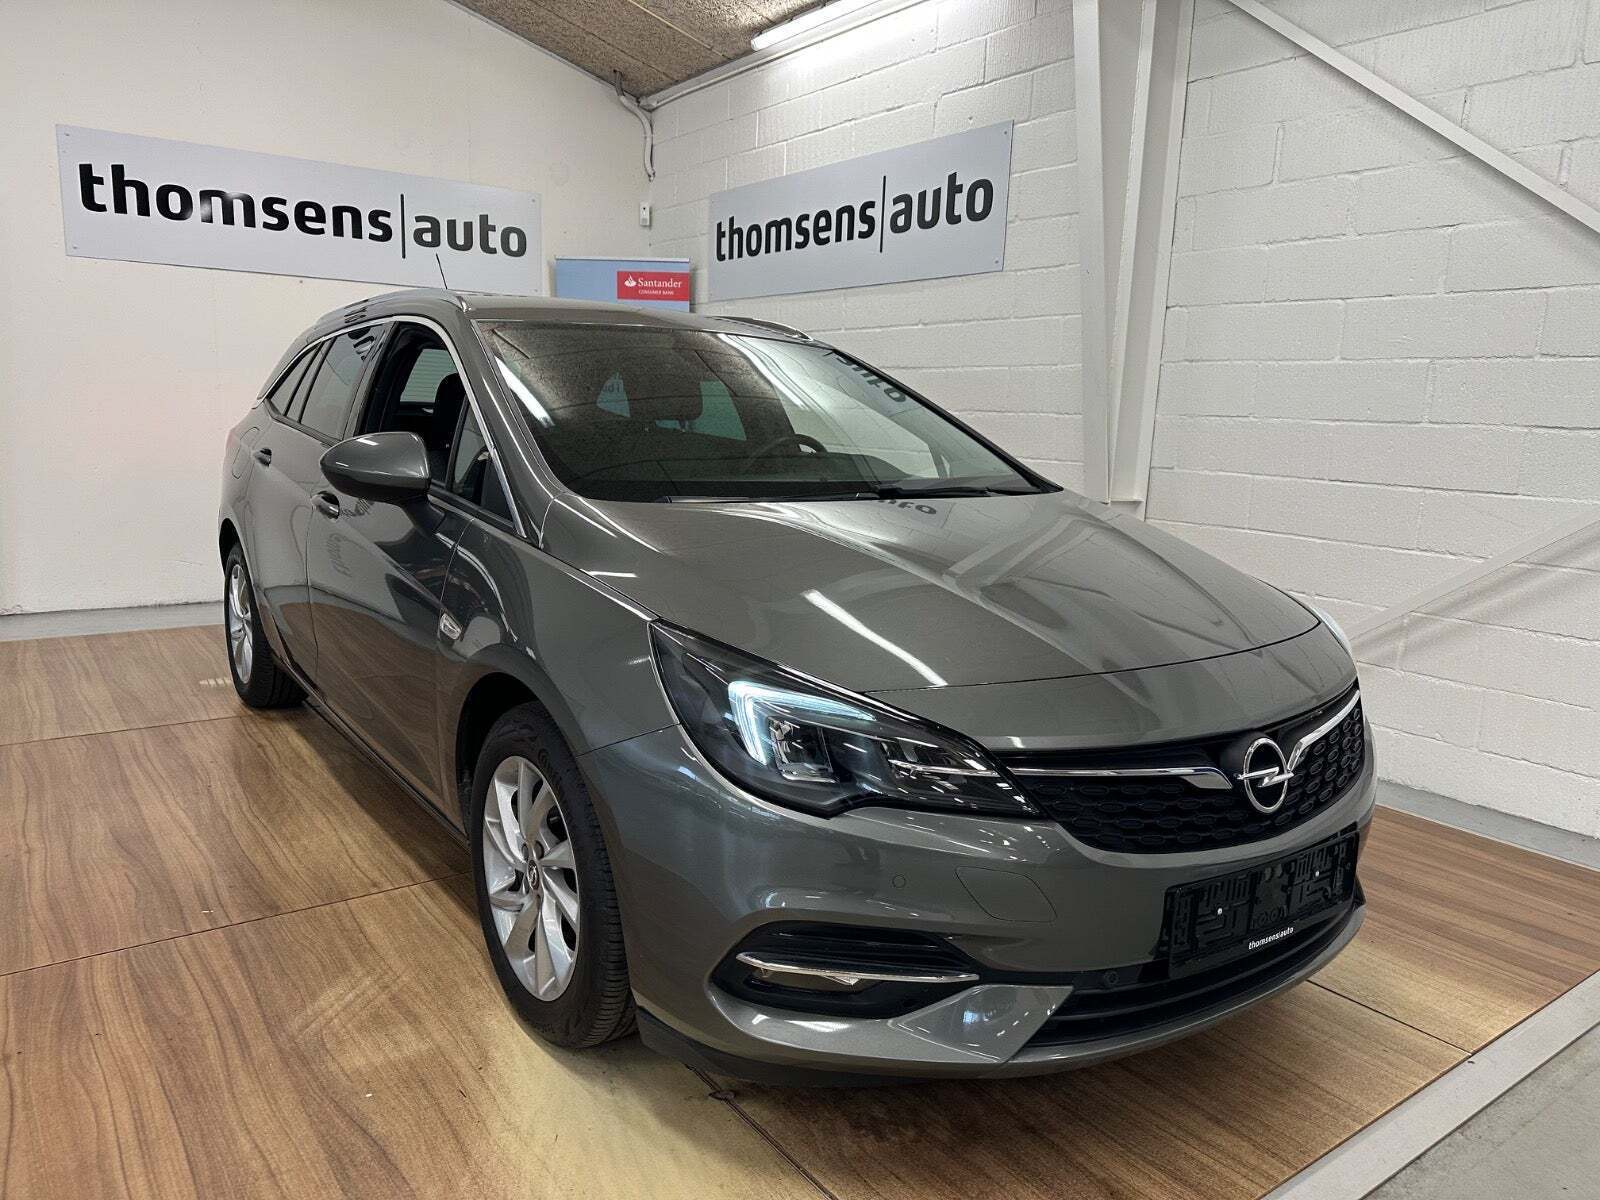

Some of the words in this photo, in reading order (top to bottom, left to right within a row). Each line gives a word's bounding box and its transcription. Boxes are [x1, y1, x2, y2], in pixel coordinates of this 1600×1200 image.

[78, 163, 393, 243] thomsens
[413, 213, 527, 258] auto
[715, 200, 876, 262] thomsens
[890, 171, 994, 235] auto
[638, 277, 682, 288] Santander
